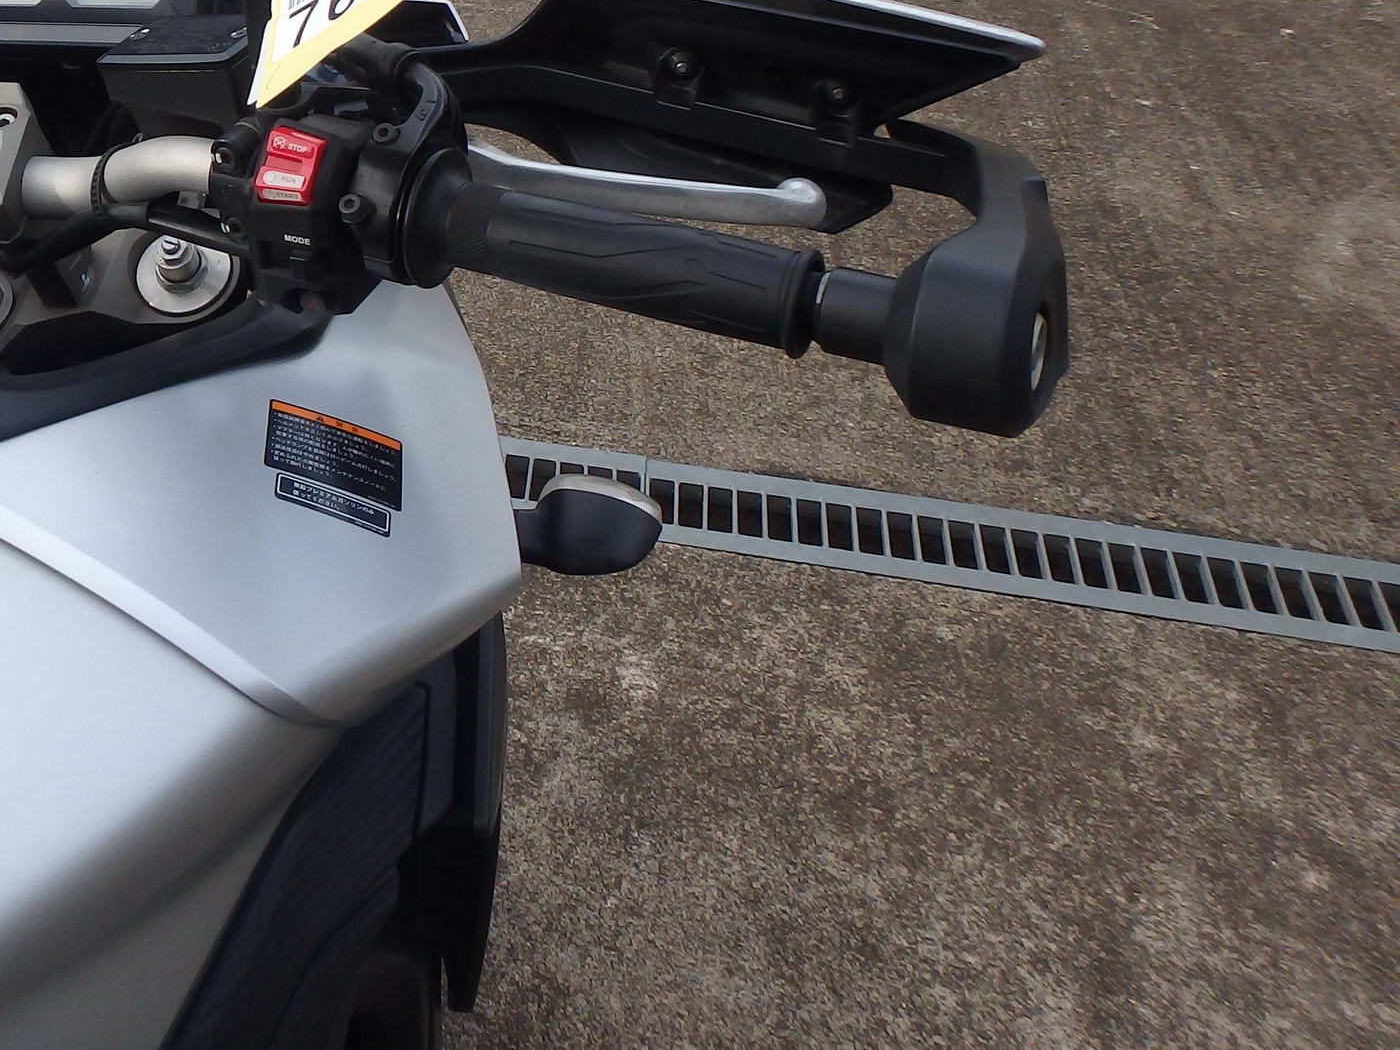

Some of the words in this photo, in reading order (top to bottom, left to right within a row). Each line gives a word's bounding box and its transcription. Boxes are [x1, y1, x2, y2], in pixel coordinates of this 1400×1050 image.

[288, 143, 308, 153] STOP
[280, 175, 297, 184] RUN
[276, 191, 298, 200] START
[284, 234, 311, 246] MODE
